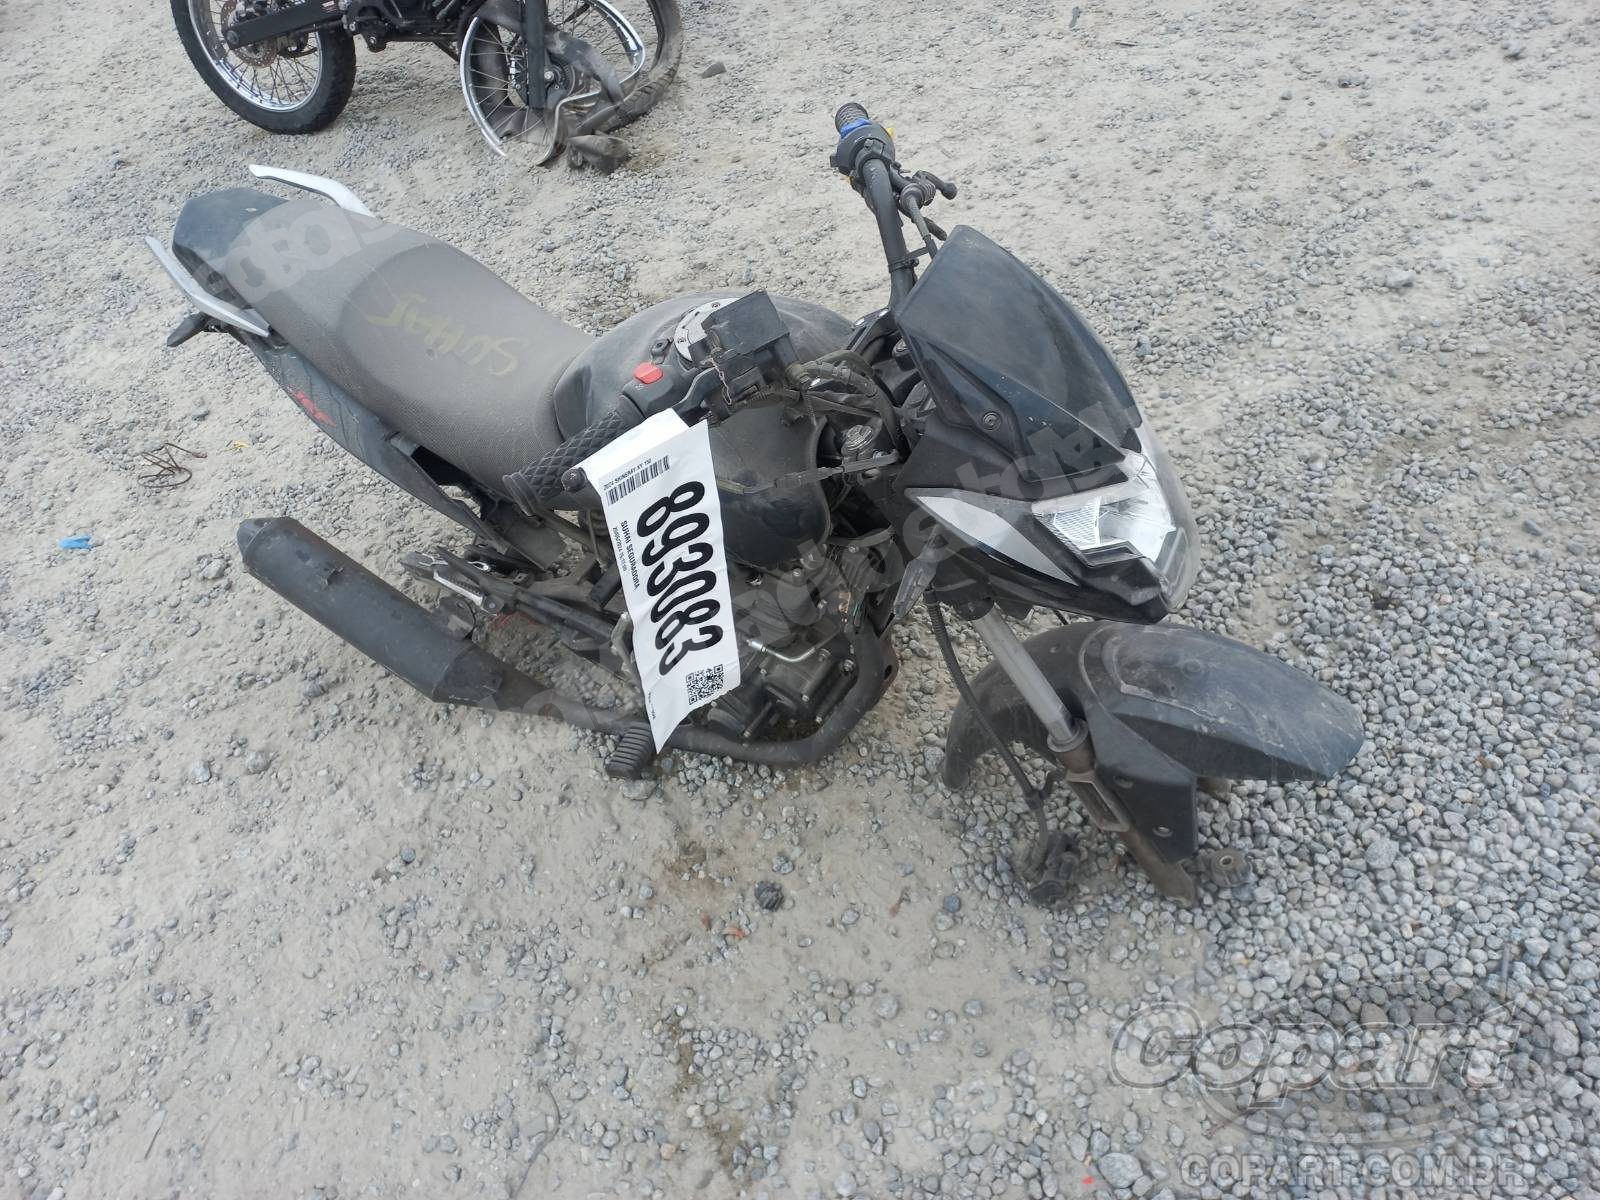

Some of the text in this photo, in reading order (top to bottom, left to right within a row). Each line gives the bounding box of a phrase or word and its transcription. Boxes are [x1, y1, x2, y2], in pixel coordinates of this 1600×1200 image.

[620, 520, 641, 590] SUHAI SEGURADORA
[636, 480, 724, 676] 893083
